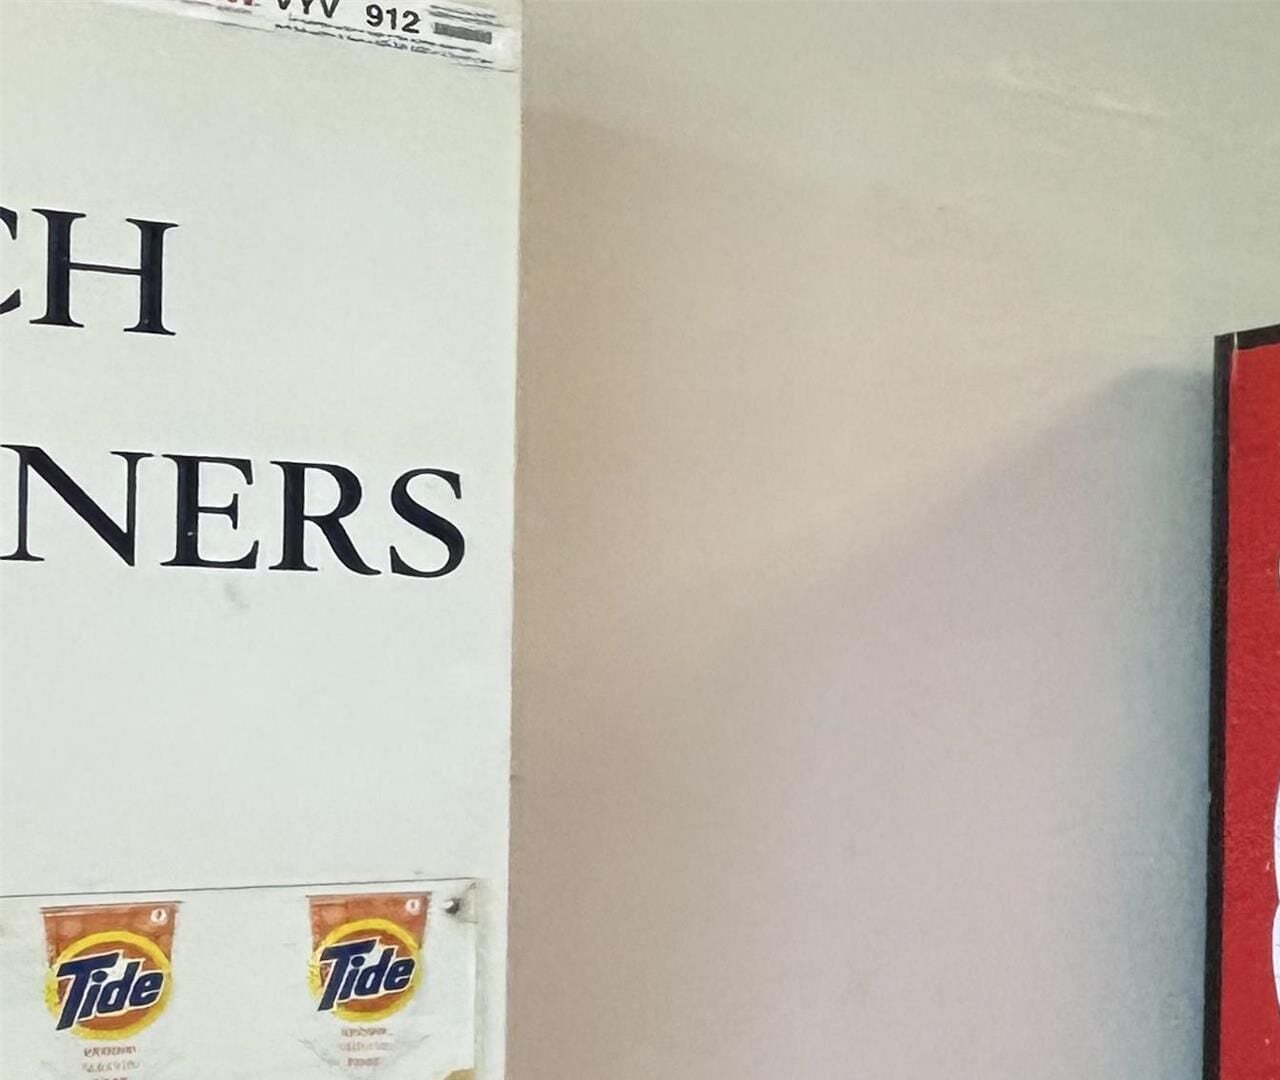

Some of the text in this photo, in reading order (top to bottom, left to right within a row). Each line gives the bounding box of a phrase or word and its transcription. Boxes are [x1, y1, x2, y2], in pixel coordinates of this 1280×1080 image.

[365, 4, 421, 34] 912
[0, 206, 180, 336] H
[0, 445, 466, 578] NERS
[55, 952, 165, 1031] Tide
[316, 939, 415, 1012] Tide
